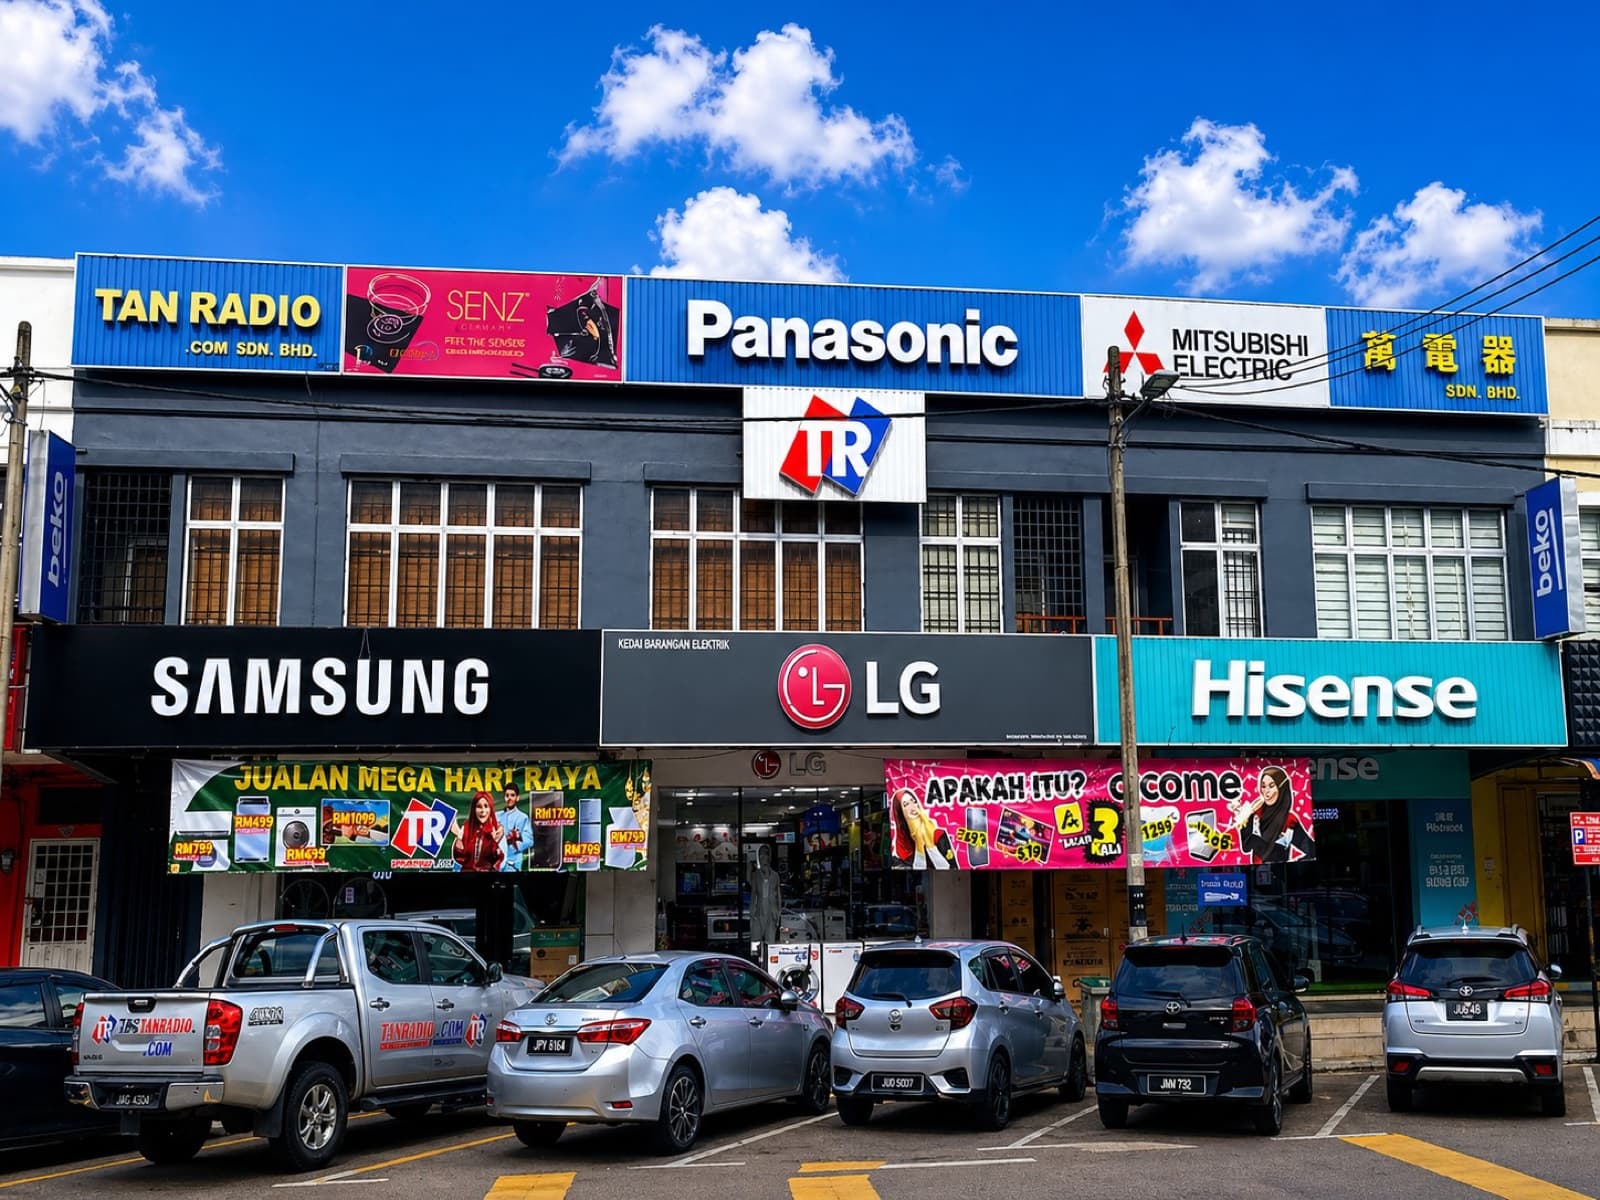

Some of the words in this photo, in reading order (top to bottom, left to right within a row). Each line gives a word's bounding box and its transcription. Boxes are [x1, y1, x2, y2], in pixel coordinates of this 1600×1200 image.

[95, 288, 179, 323] TAN
[190, 291, 321, 328] RADIO
[446, 289, 525, 323] SENZ
[687, 299, 1019, 367] Panasonic
[1172, 328, 1309, 357] MITSUBISHI
[185, 341, 228, 355] .COM
[236, 342, 274, 356] SDN.
[279, 343, 318, 358] BHD.
[1173, 354, 1293, 381] ELECTRIC
[1446, 384, 1482, 399] SDN.
[1487, 385, 1521, 400] BHD.
[799, 420, 873, 478] TR
[48, 471, 64, 588] beko
[1533, 509, 1554, 598] beko
[618, 638, 643, 649] KEDAI
[644, 638, 690, 650] BARANGAN
[691, 638, 731, 650] ELEKTRIK
[150, 656, 490, 717] SAMSUNG
[865, 660, 941, 716] LG
[1191, 658, 1478, 720] Hisense
[233, 764, 349, 792] JUALAN
[357, 766, 437, 793] MEGA
[445, 766, 513, 793] HARI
[523, 765, 602, 792] RAYA
[789, 751, 827, 777] LG
[926, 774, 1025, 806] APAKAH
[1031, 772, 1086, 800] ITU?
[234, 815, 274, 829] RM499
[402, 810, 447, 847] TR
[1574, 829, 1584, 844] P
[143, 1041, 173, 1057] .COM
[1177, 1077, 1192, 1091] 732
